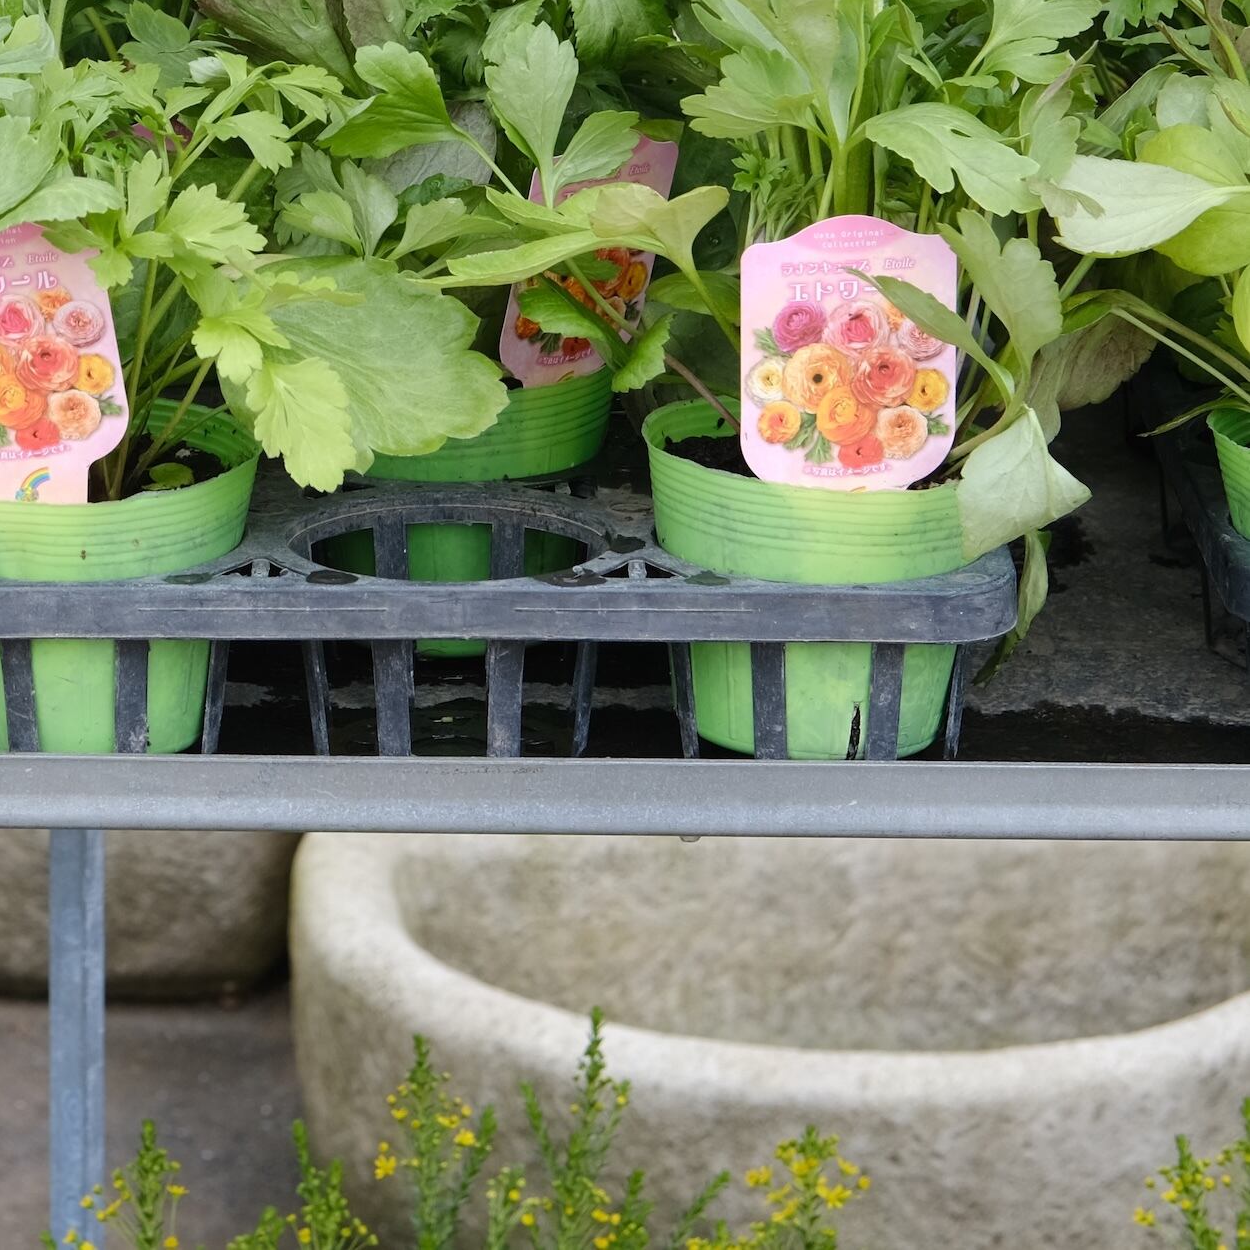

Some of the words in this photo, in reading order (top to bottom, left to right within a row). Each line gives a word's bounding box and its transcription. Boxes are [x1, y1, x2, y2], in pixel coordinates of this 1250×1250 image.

[840, 230, 885, 239] Original
[822, 240, 877, 249] Collection
[28, 253, 59, 264] Etoile
[884, 257, 915, 269] Etoile
[790, 280, 880, 302] エトワー
